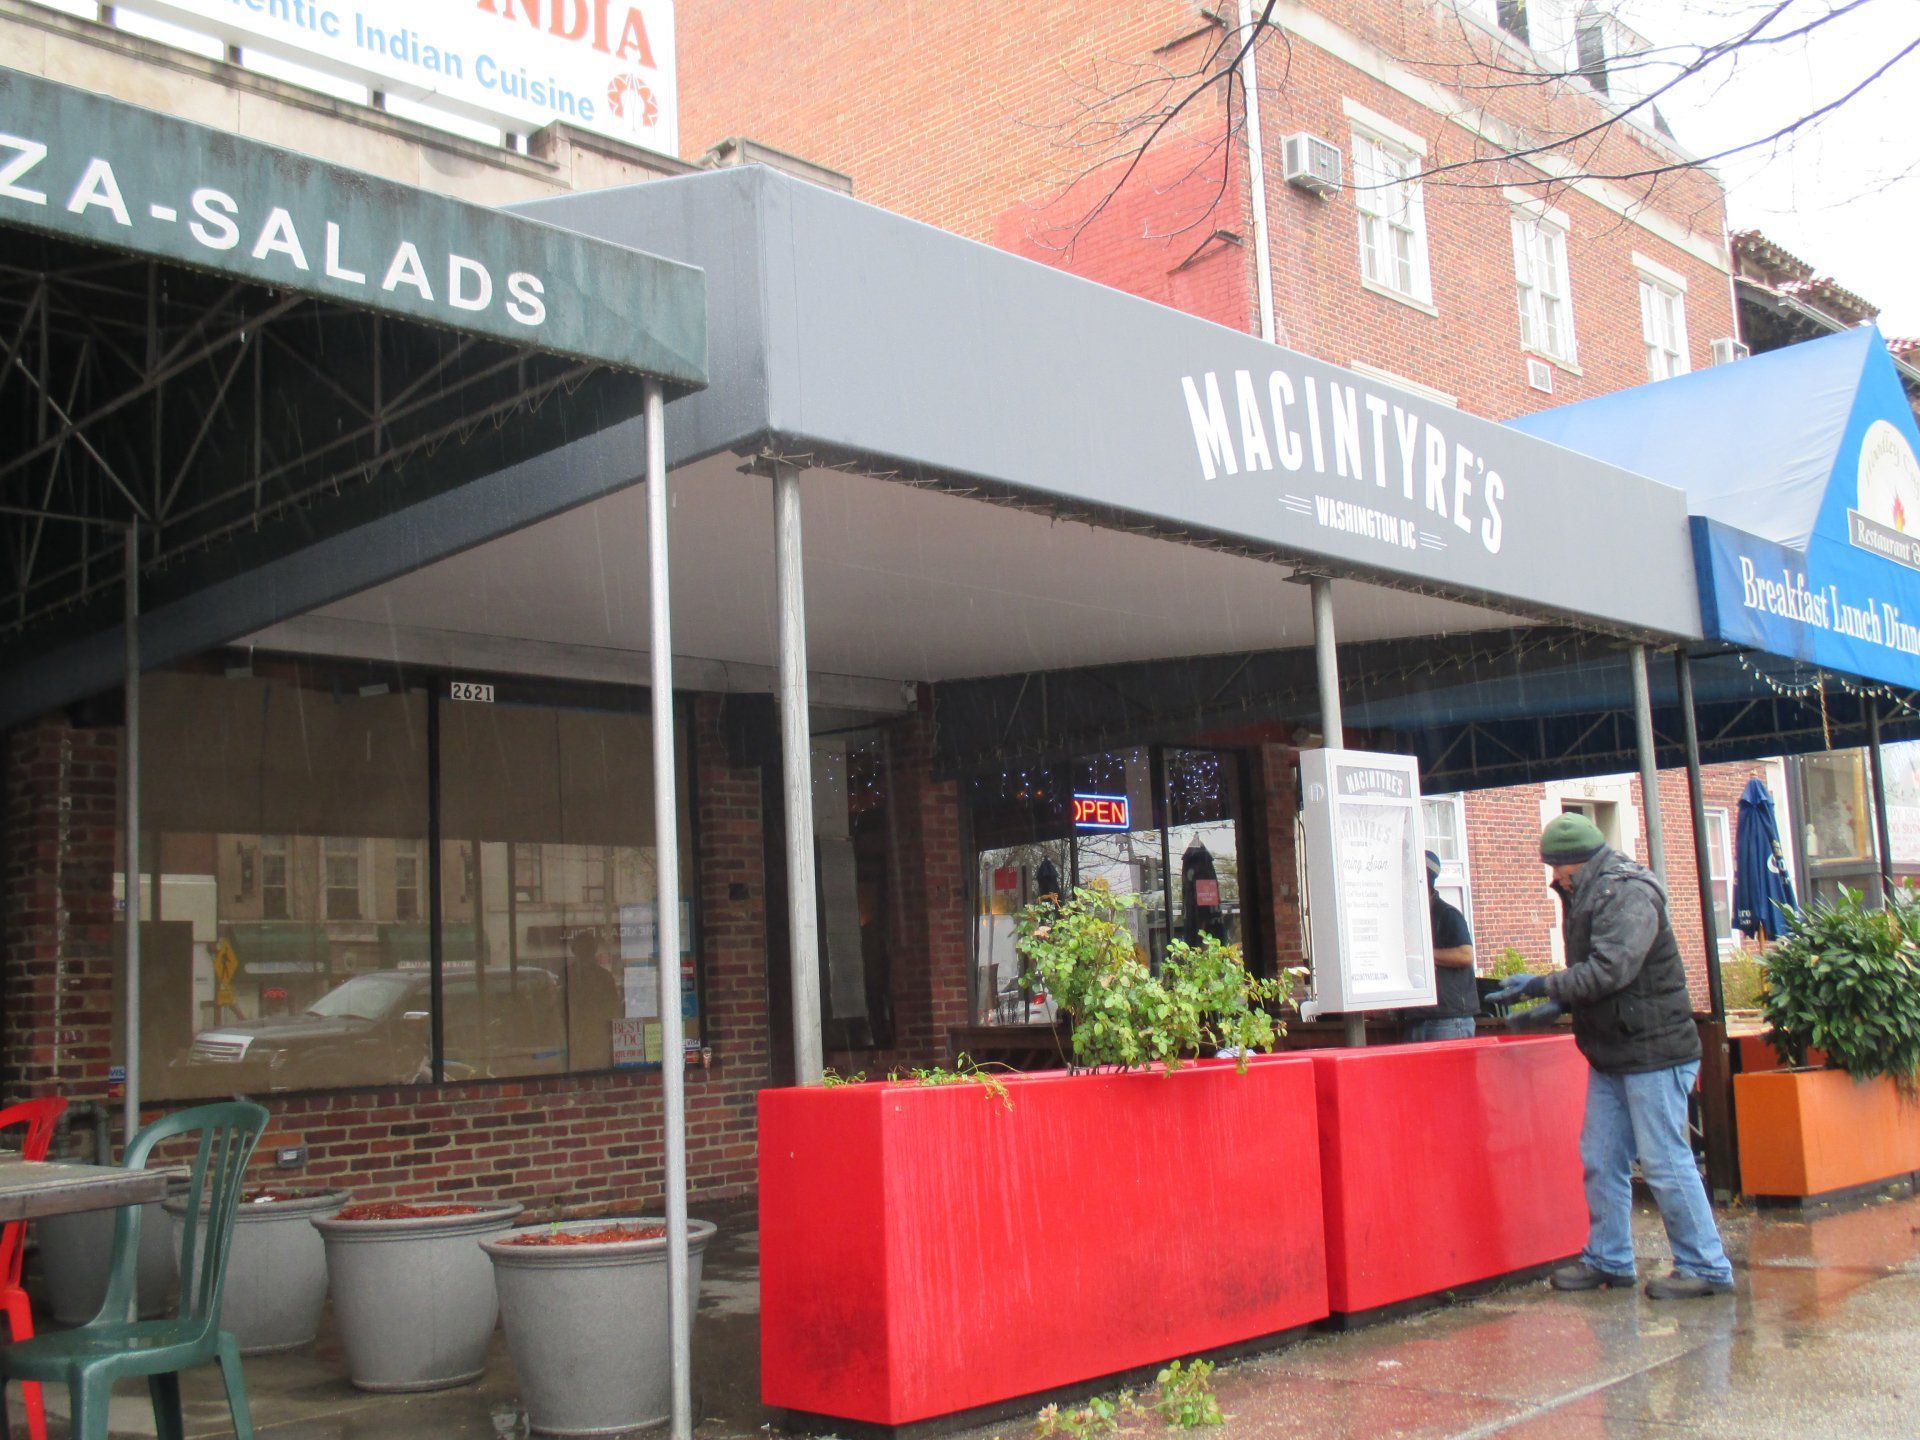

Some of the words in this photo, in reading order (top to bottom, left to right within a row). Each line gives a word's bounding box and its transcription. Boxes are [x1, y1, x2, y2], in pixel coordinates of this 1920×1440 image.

[476, 0, 657, 70] DIA
[355, 12, 463, 79] Indian
[475, 54, 596, 121] Cuisine
[1181, 369, 1505, 554] MACINTYRE'S
[1315, 495, 1399, 546] WASHINGTON
[1401, 519, 1417, 550] DC
[1856, 519, 1910, 563] Restaurant
[1739, 556, 1829, 630] Breakfast
[1829, 585, 1881, 645] Lunch
[1881, 602, 1920, 656] Dinn
[453, 683, 491, 702] 2621
[614, 1022, 641, 1034] BEST
